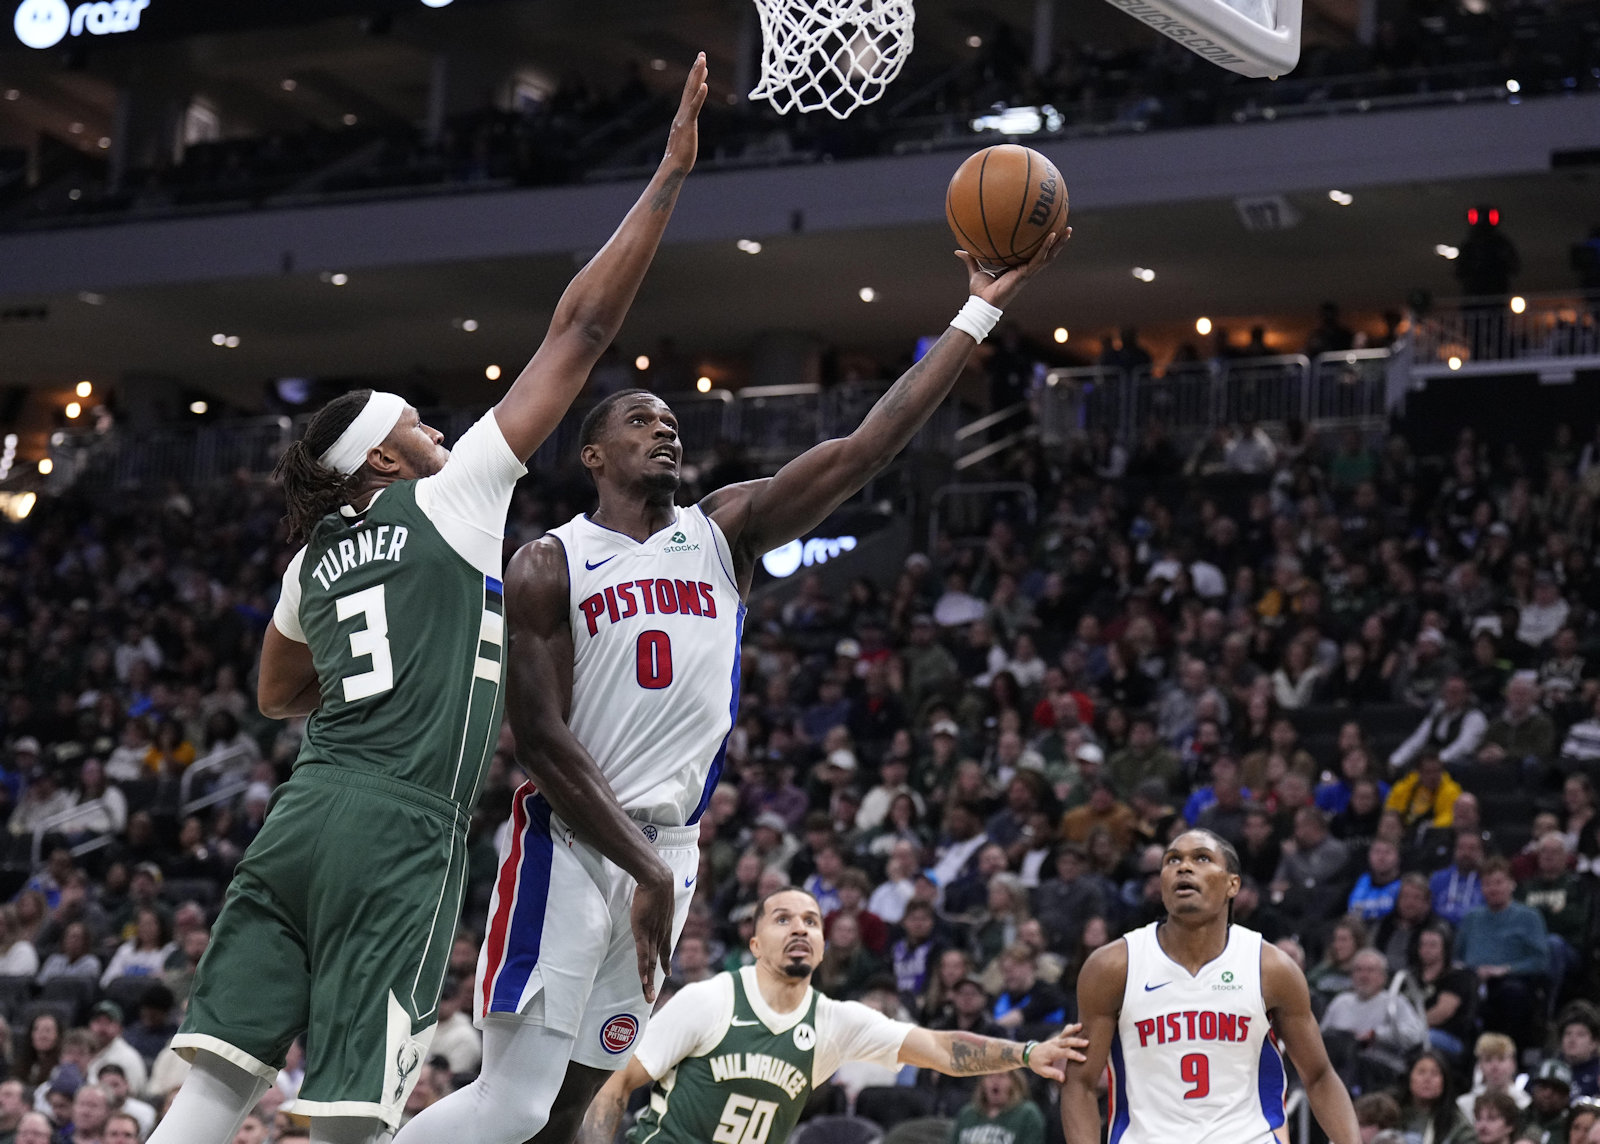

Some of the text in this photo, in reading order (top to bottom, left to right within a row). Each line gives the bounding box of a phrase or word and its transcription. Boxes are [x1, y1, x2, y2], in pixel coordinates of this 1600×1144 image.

[311, 525, 409, 591] TURNER
[578, 578, 718, 639] PISTONS
[335, 583, 394, 703] 3
[636, 629, 674, 690] 0
[607, 1031, 630, 1042] PISTONS
[611, 1025, 633, 1036] DETROIT
[1134, 1010, 1252, 1048] PISTONS
[709, 1052, 808, 1101] MILWAUKEE
[1180, 1053, 1210, 1100] 9
[712, 1092, 780, 1144] 50
